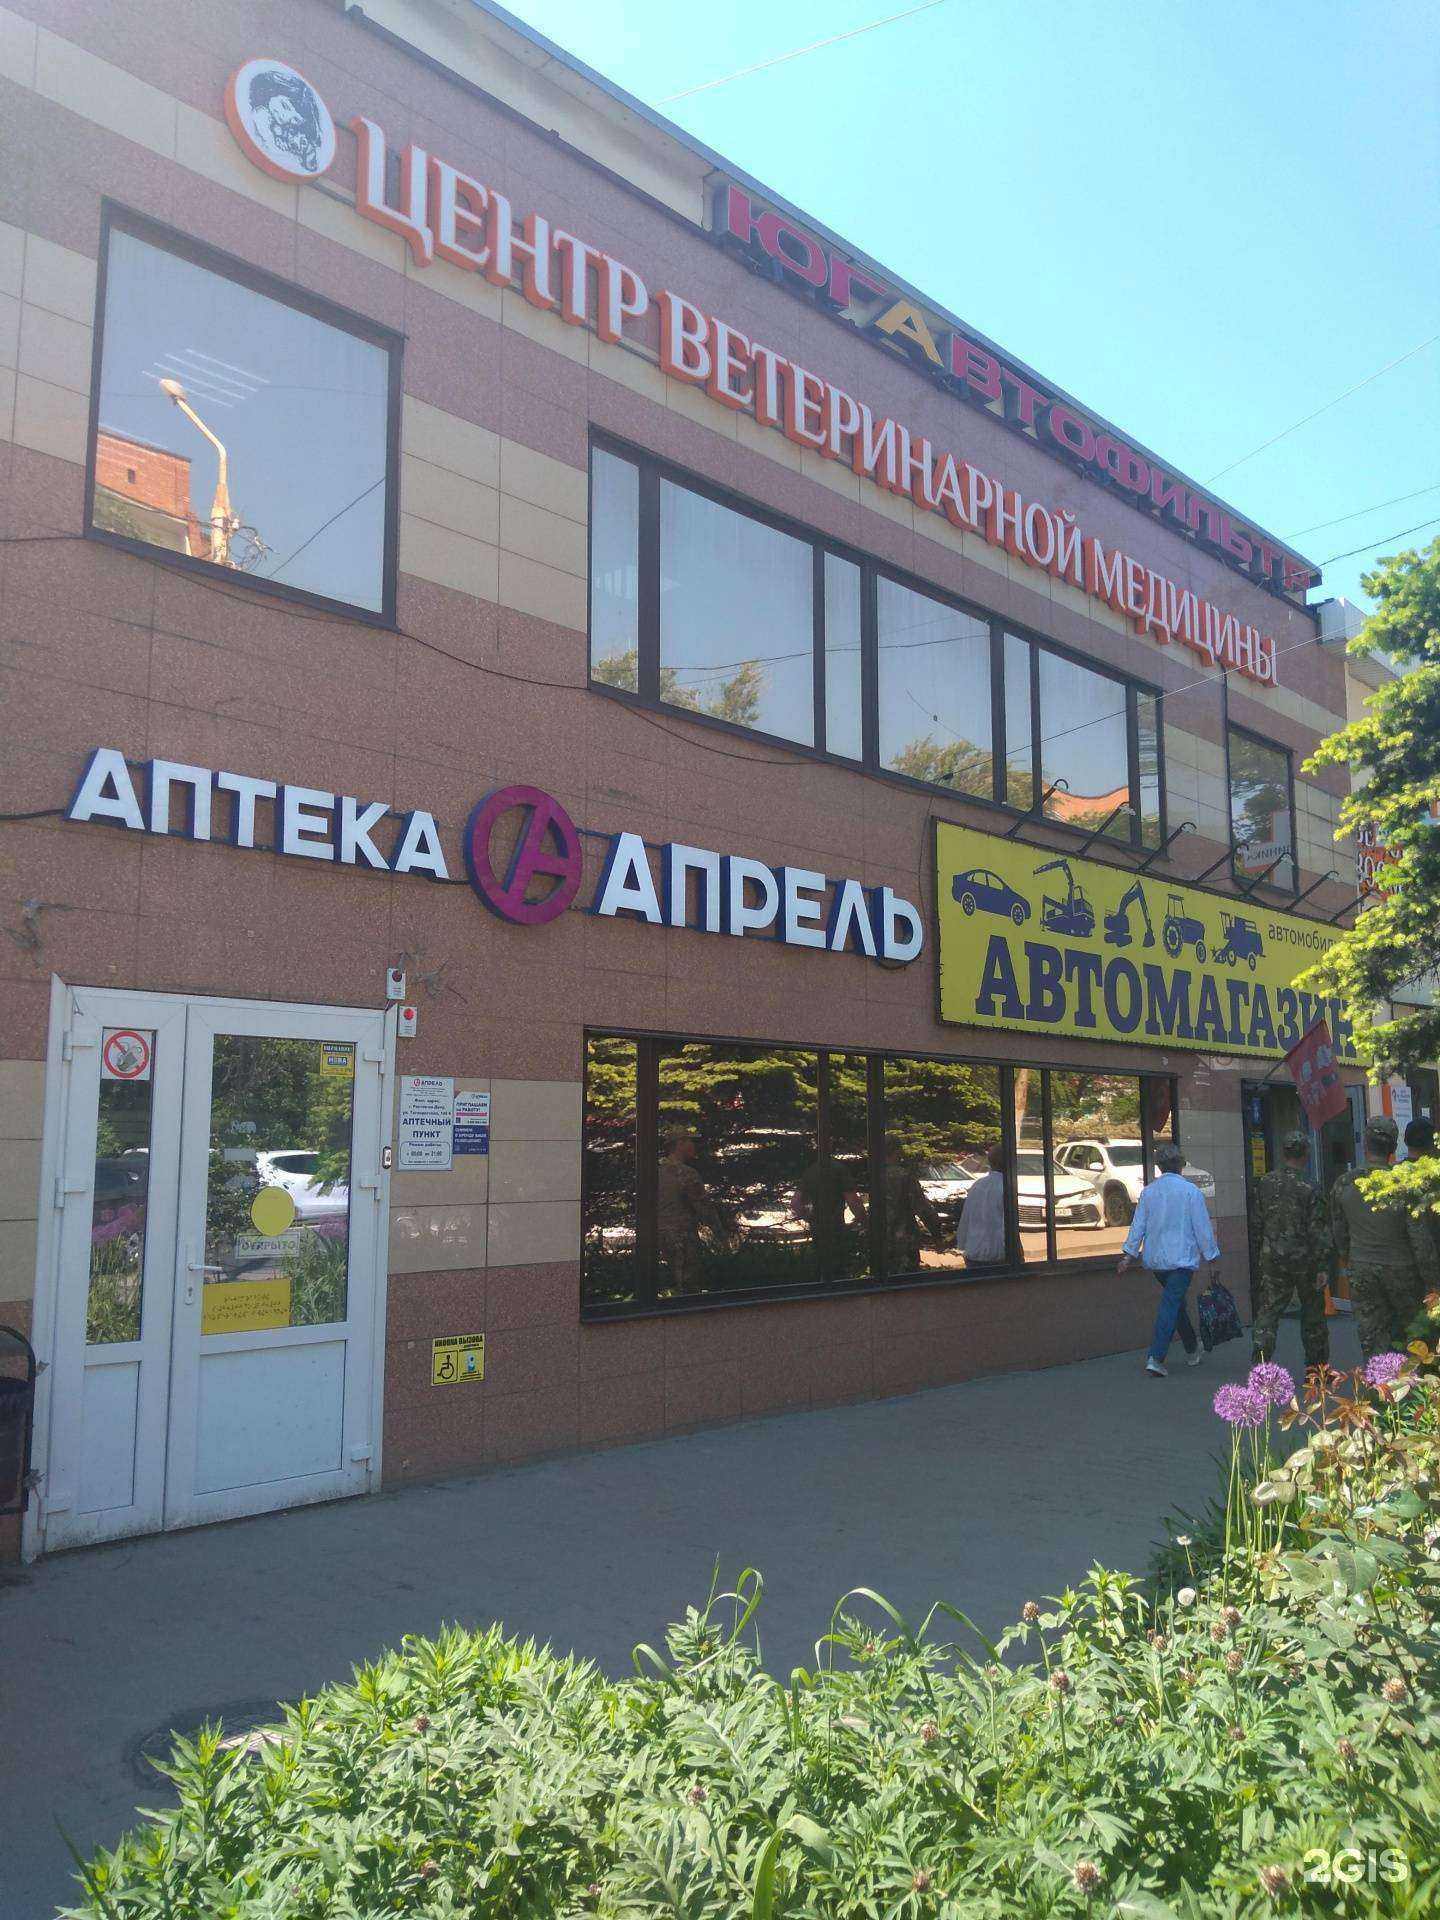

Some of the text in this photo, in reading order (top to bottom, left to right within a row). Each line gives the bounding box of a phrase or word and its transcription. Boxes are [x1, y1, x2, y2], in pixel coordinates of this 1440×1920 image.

[353, 115, 1279, 688] ЦЕНТР ВЕТЕРИНАРНОЙ МЕДИЦИНЫ
[64, 747, 450, 880] АПТЕКА
[595, 831, 925, 962] АПРЕЛЬ
[1268, 922, 1337, 952] автомобил
[974, 934, 1358, 1059] АВТОМАГАЗИН
[402, 1117, 451, 1126] АПТЕЧНЫЙ
[412, 1130, 441, 1138] ПУНКТ
